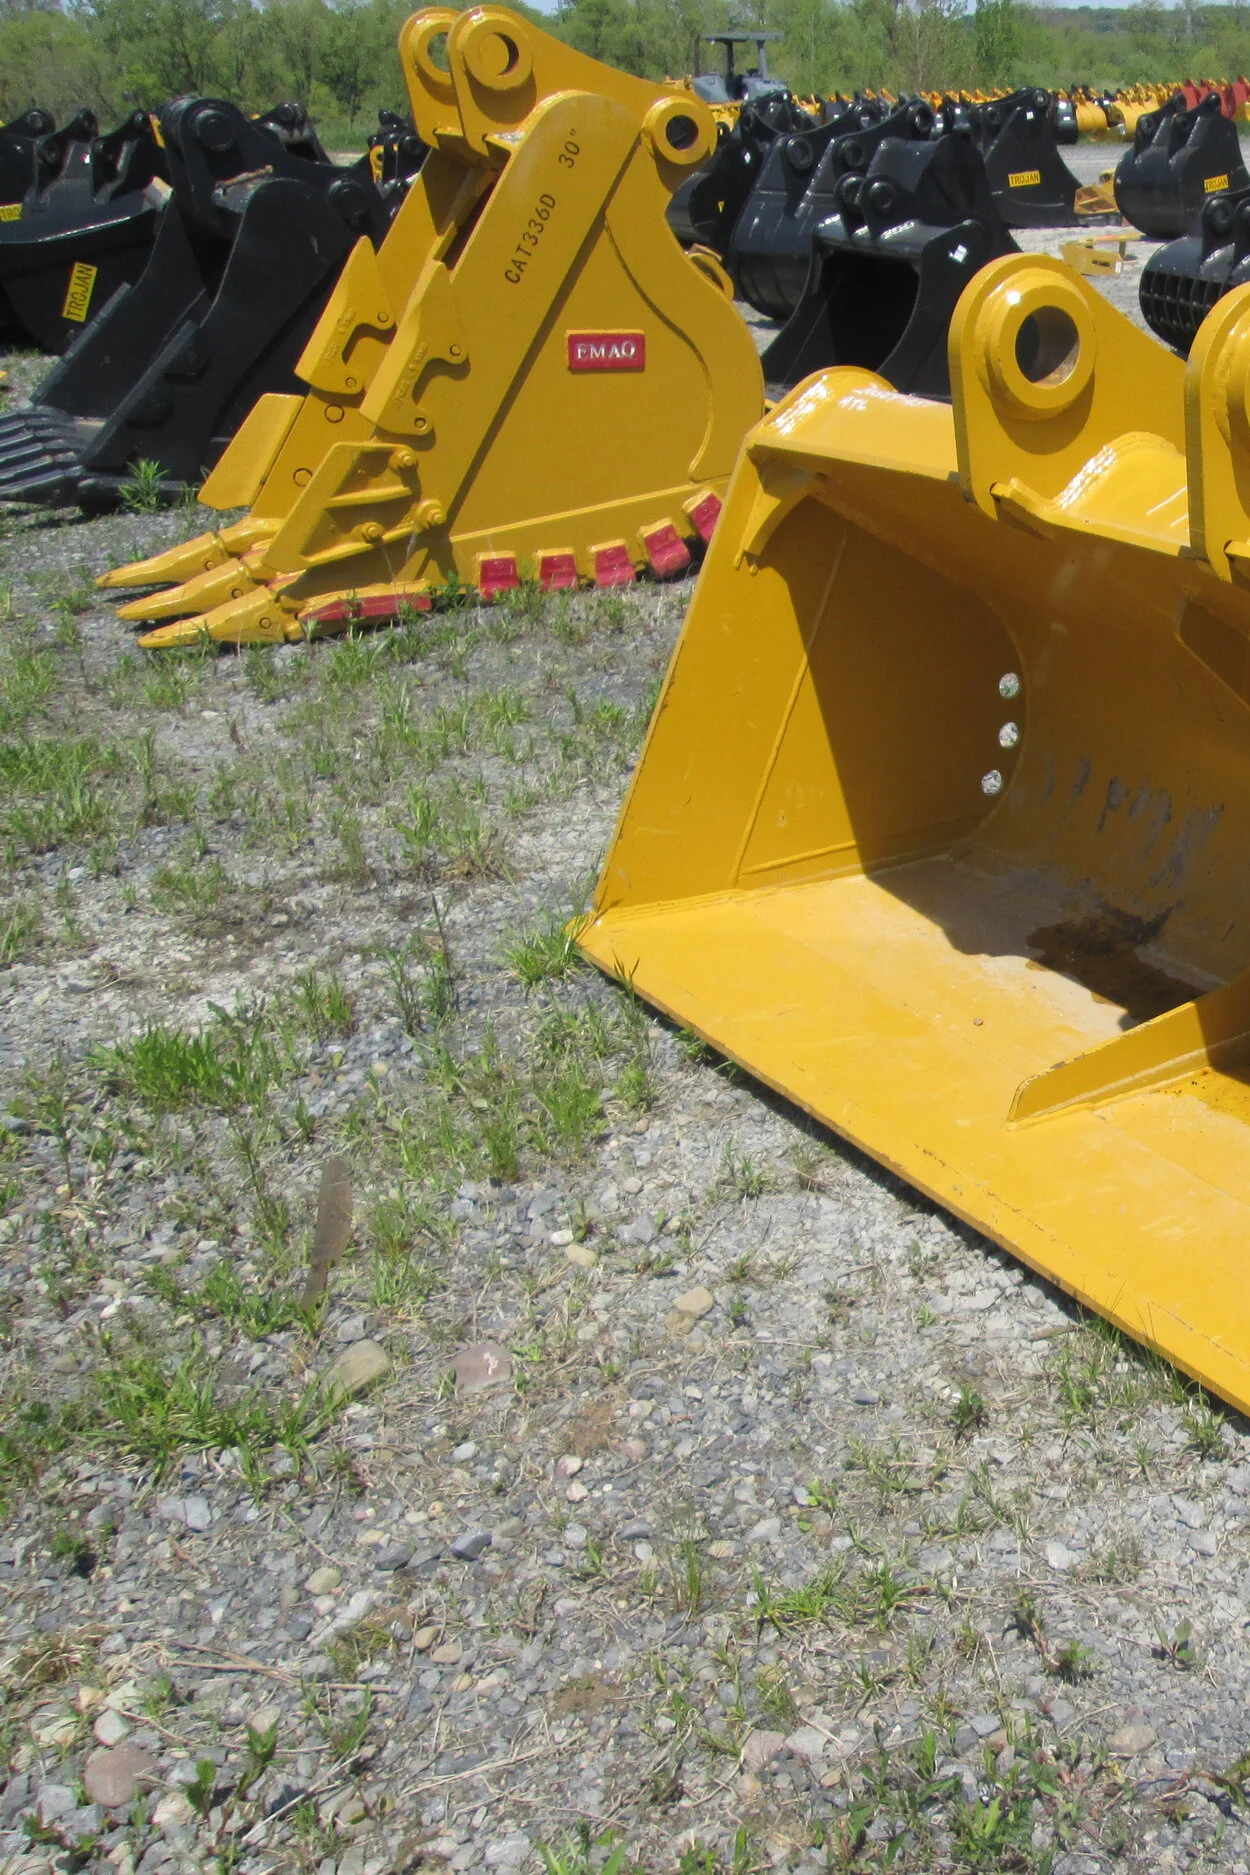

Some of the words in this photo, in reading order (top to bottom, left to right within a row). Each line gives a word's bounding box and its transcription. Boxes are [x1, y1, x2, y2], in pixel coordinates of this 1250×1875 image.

[504, 193, 556, 284] CAT336D
[558, 127, 580, 169] 30"
[1010, 173, 1039, 185] TROJAN
[66, 264, 93, 319] TROJAN
